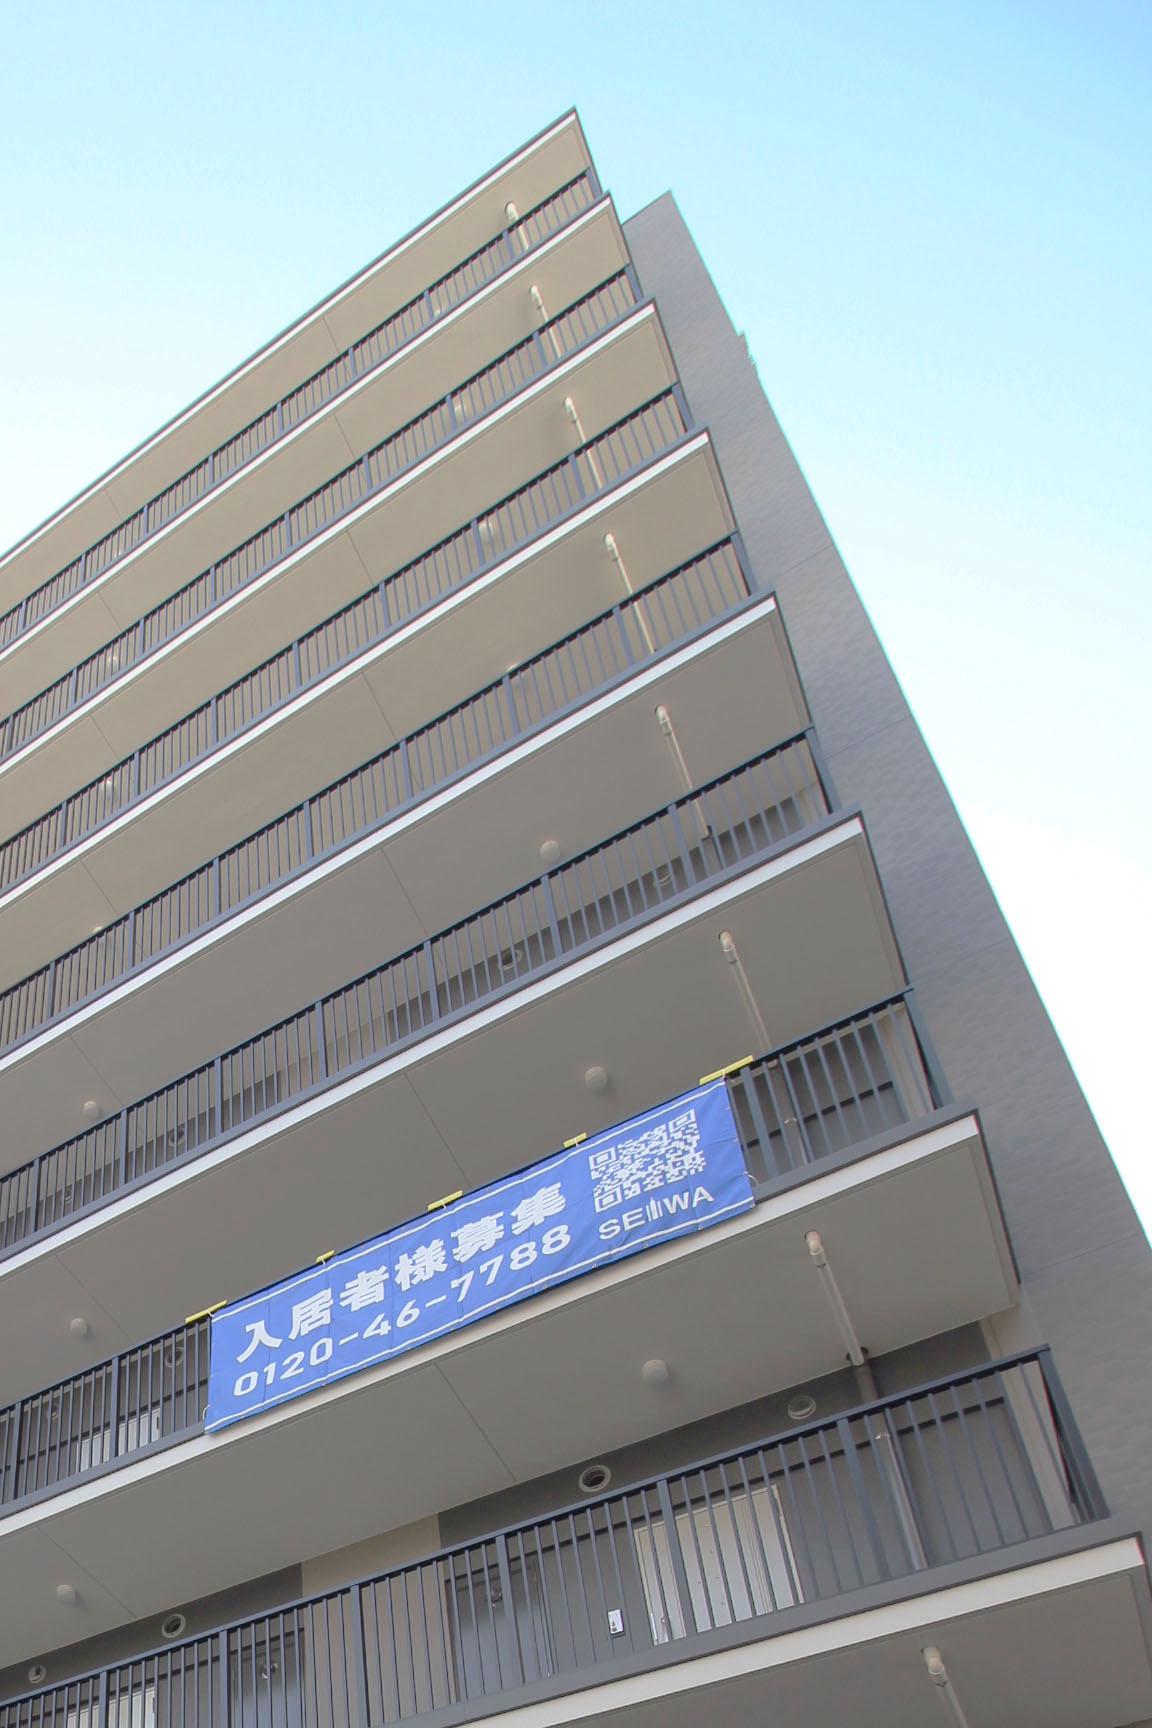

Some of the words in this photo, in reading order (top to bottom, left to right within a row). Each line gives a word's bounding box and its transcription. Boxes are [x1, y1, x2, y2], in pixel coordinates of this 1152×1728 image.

[233, 1224, 571, 1397] 0120-46-7788
[236, 1182, 566, 1364] 入居者様募集
